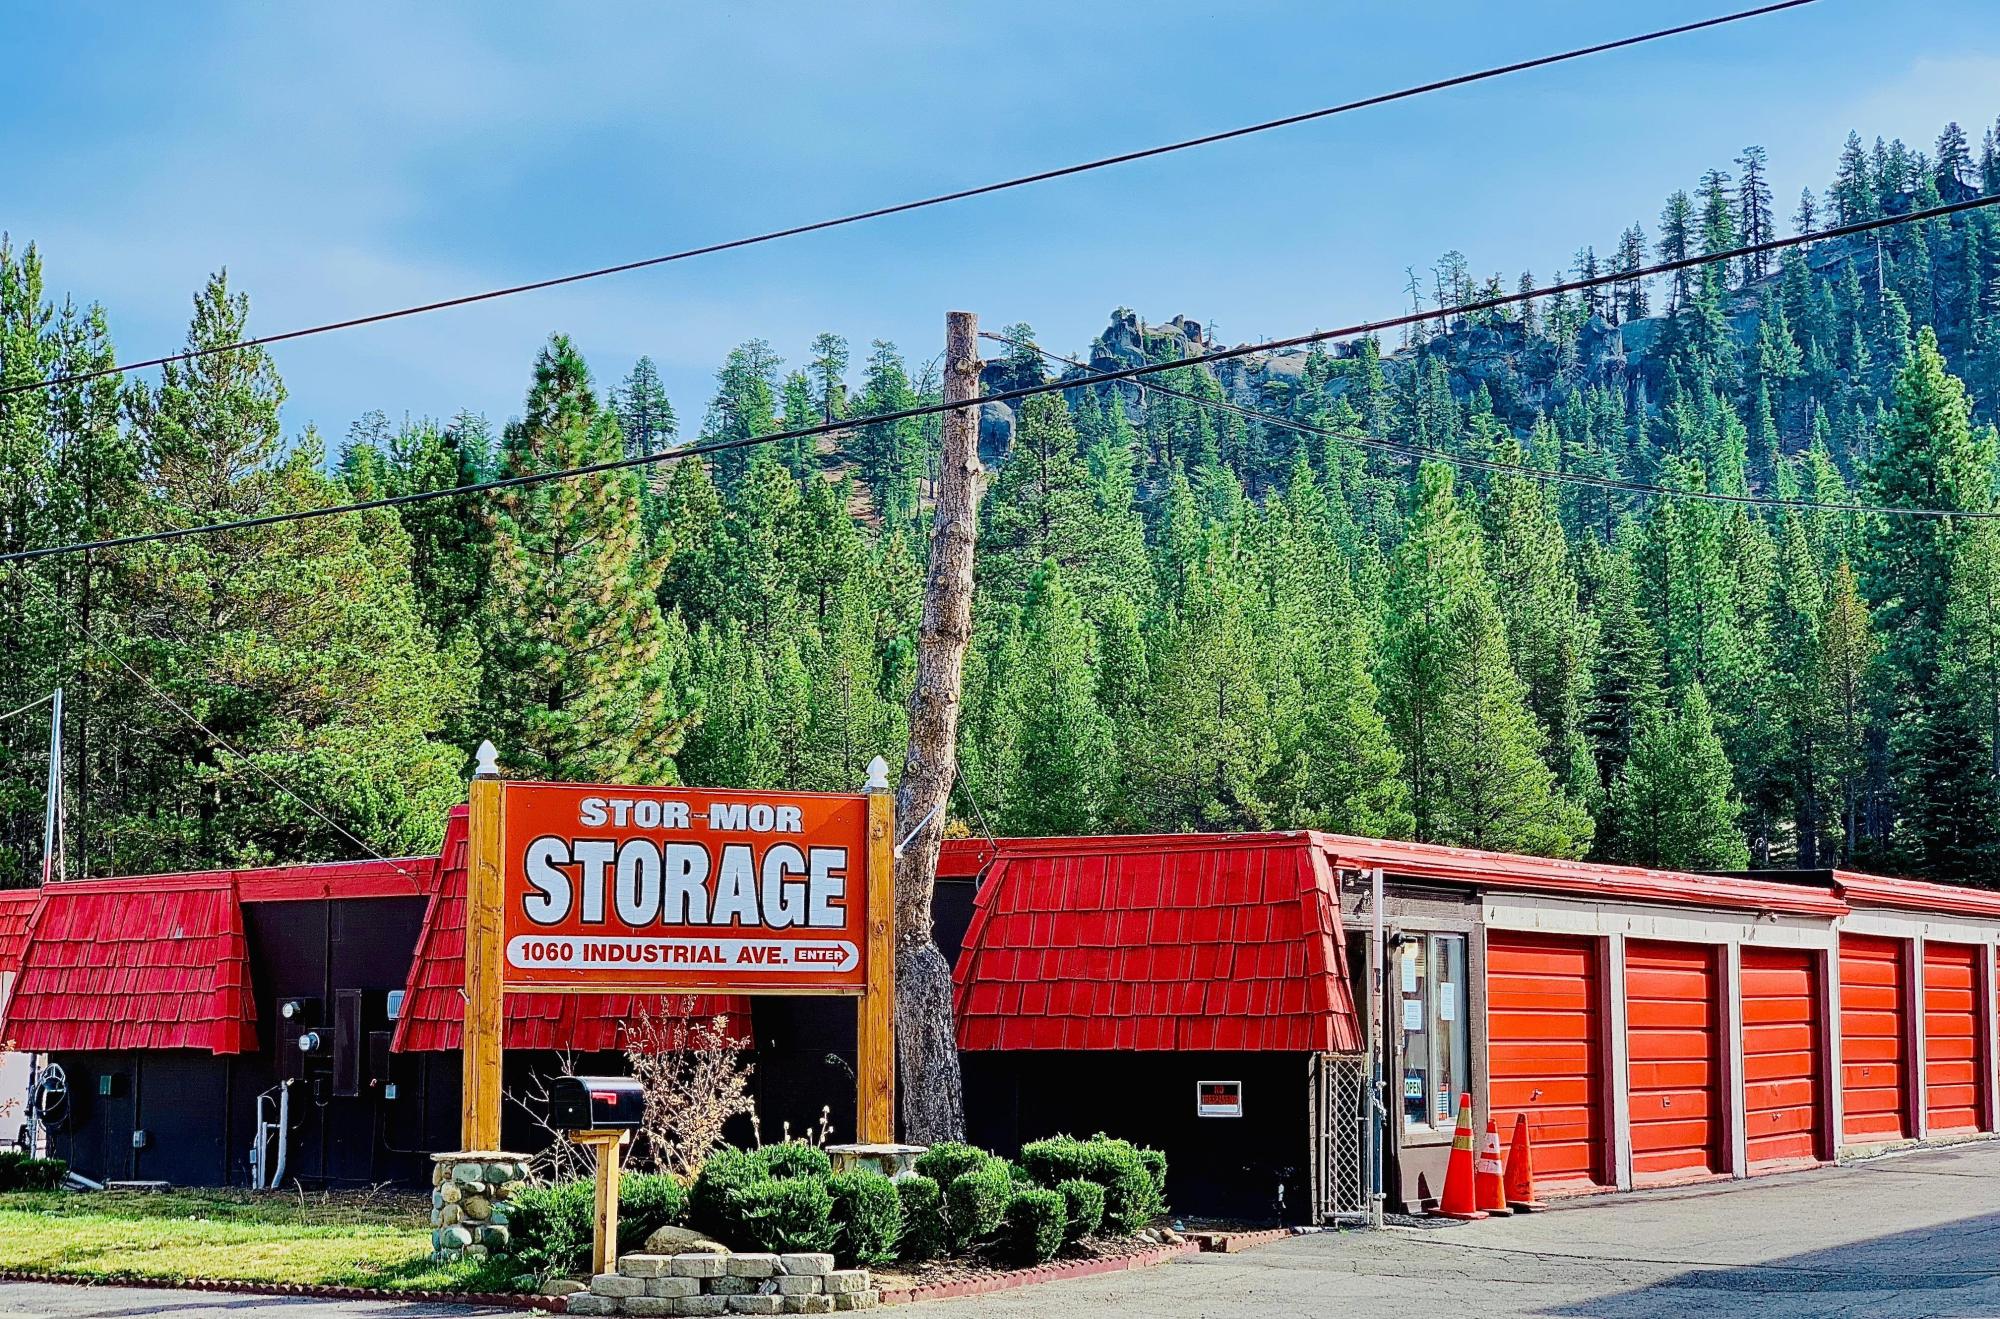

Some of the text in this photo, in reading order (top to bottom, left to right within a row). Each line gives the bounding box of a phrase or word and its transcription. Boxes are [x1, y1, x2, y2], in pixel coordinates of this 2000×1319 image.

[522, 836, 849, 929] STORAGE
[521, 942, 844, 965] 1060 INDUSTRIAL AVE. ENTER
[1405, 1081, 1421, 1094] OPEN
